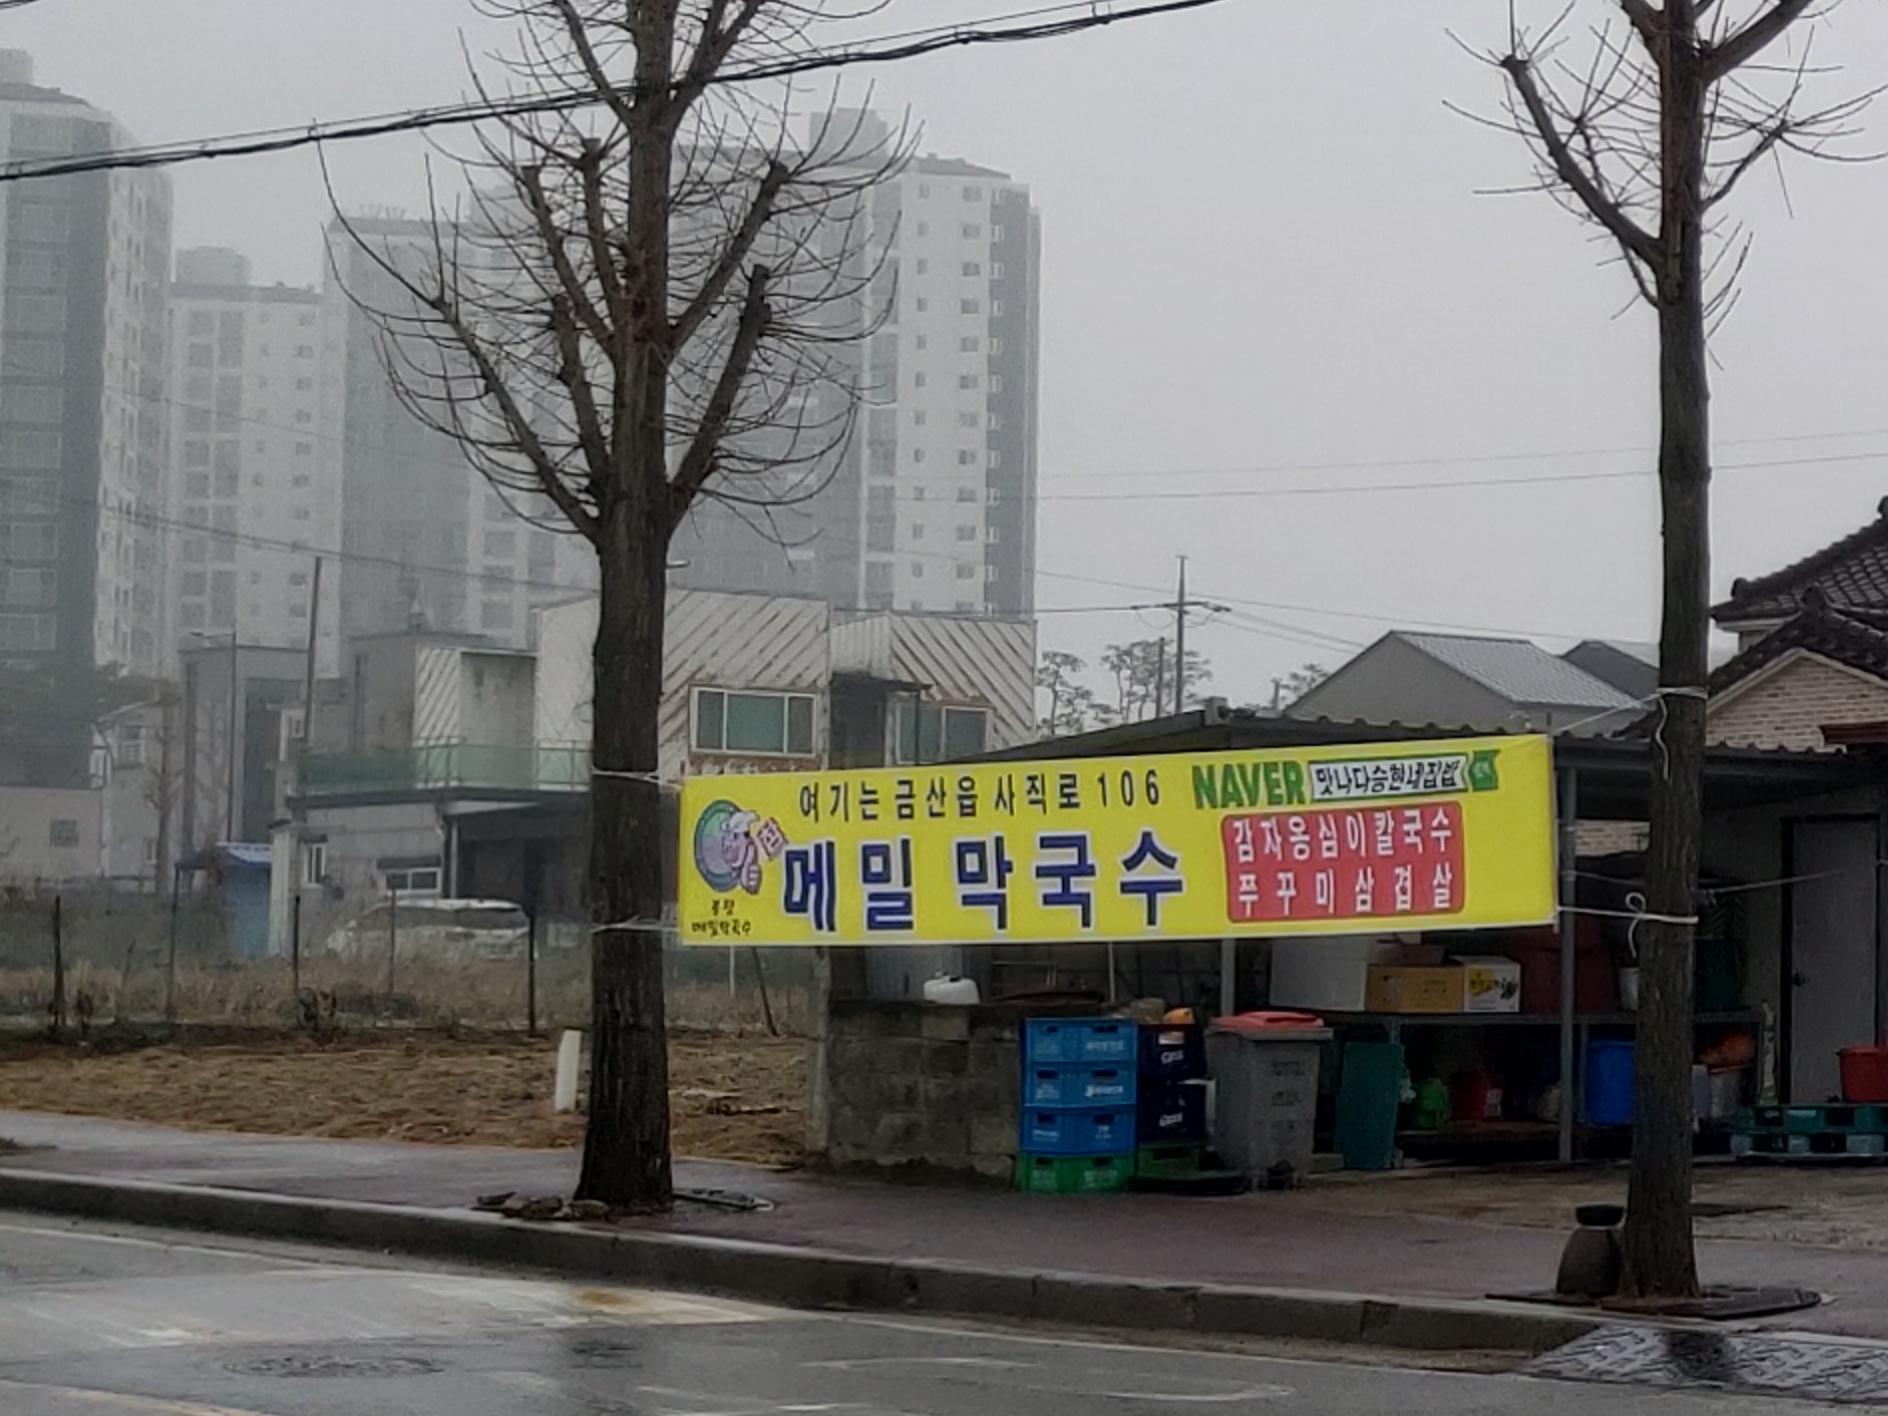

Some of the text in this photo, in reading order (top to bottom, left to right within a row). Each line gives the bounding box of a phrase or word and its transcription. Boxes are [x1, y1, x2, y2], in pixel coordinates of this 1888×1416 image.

[799, 769, 1160, 822] 여기는 금산읍 사직로 106
[1192, 760, 1306, 810] NAVER
